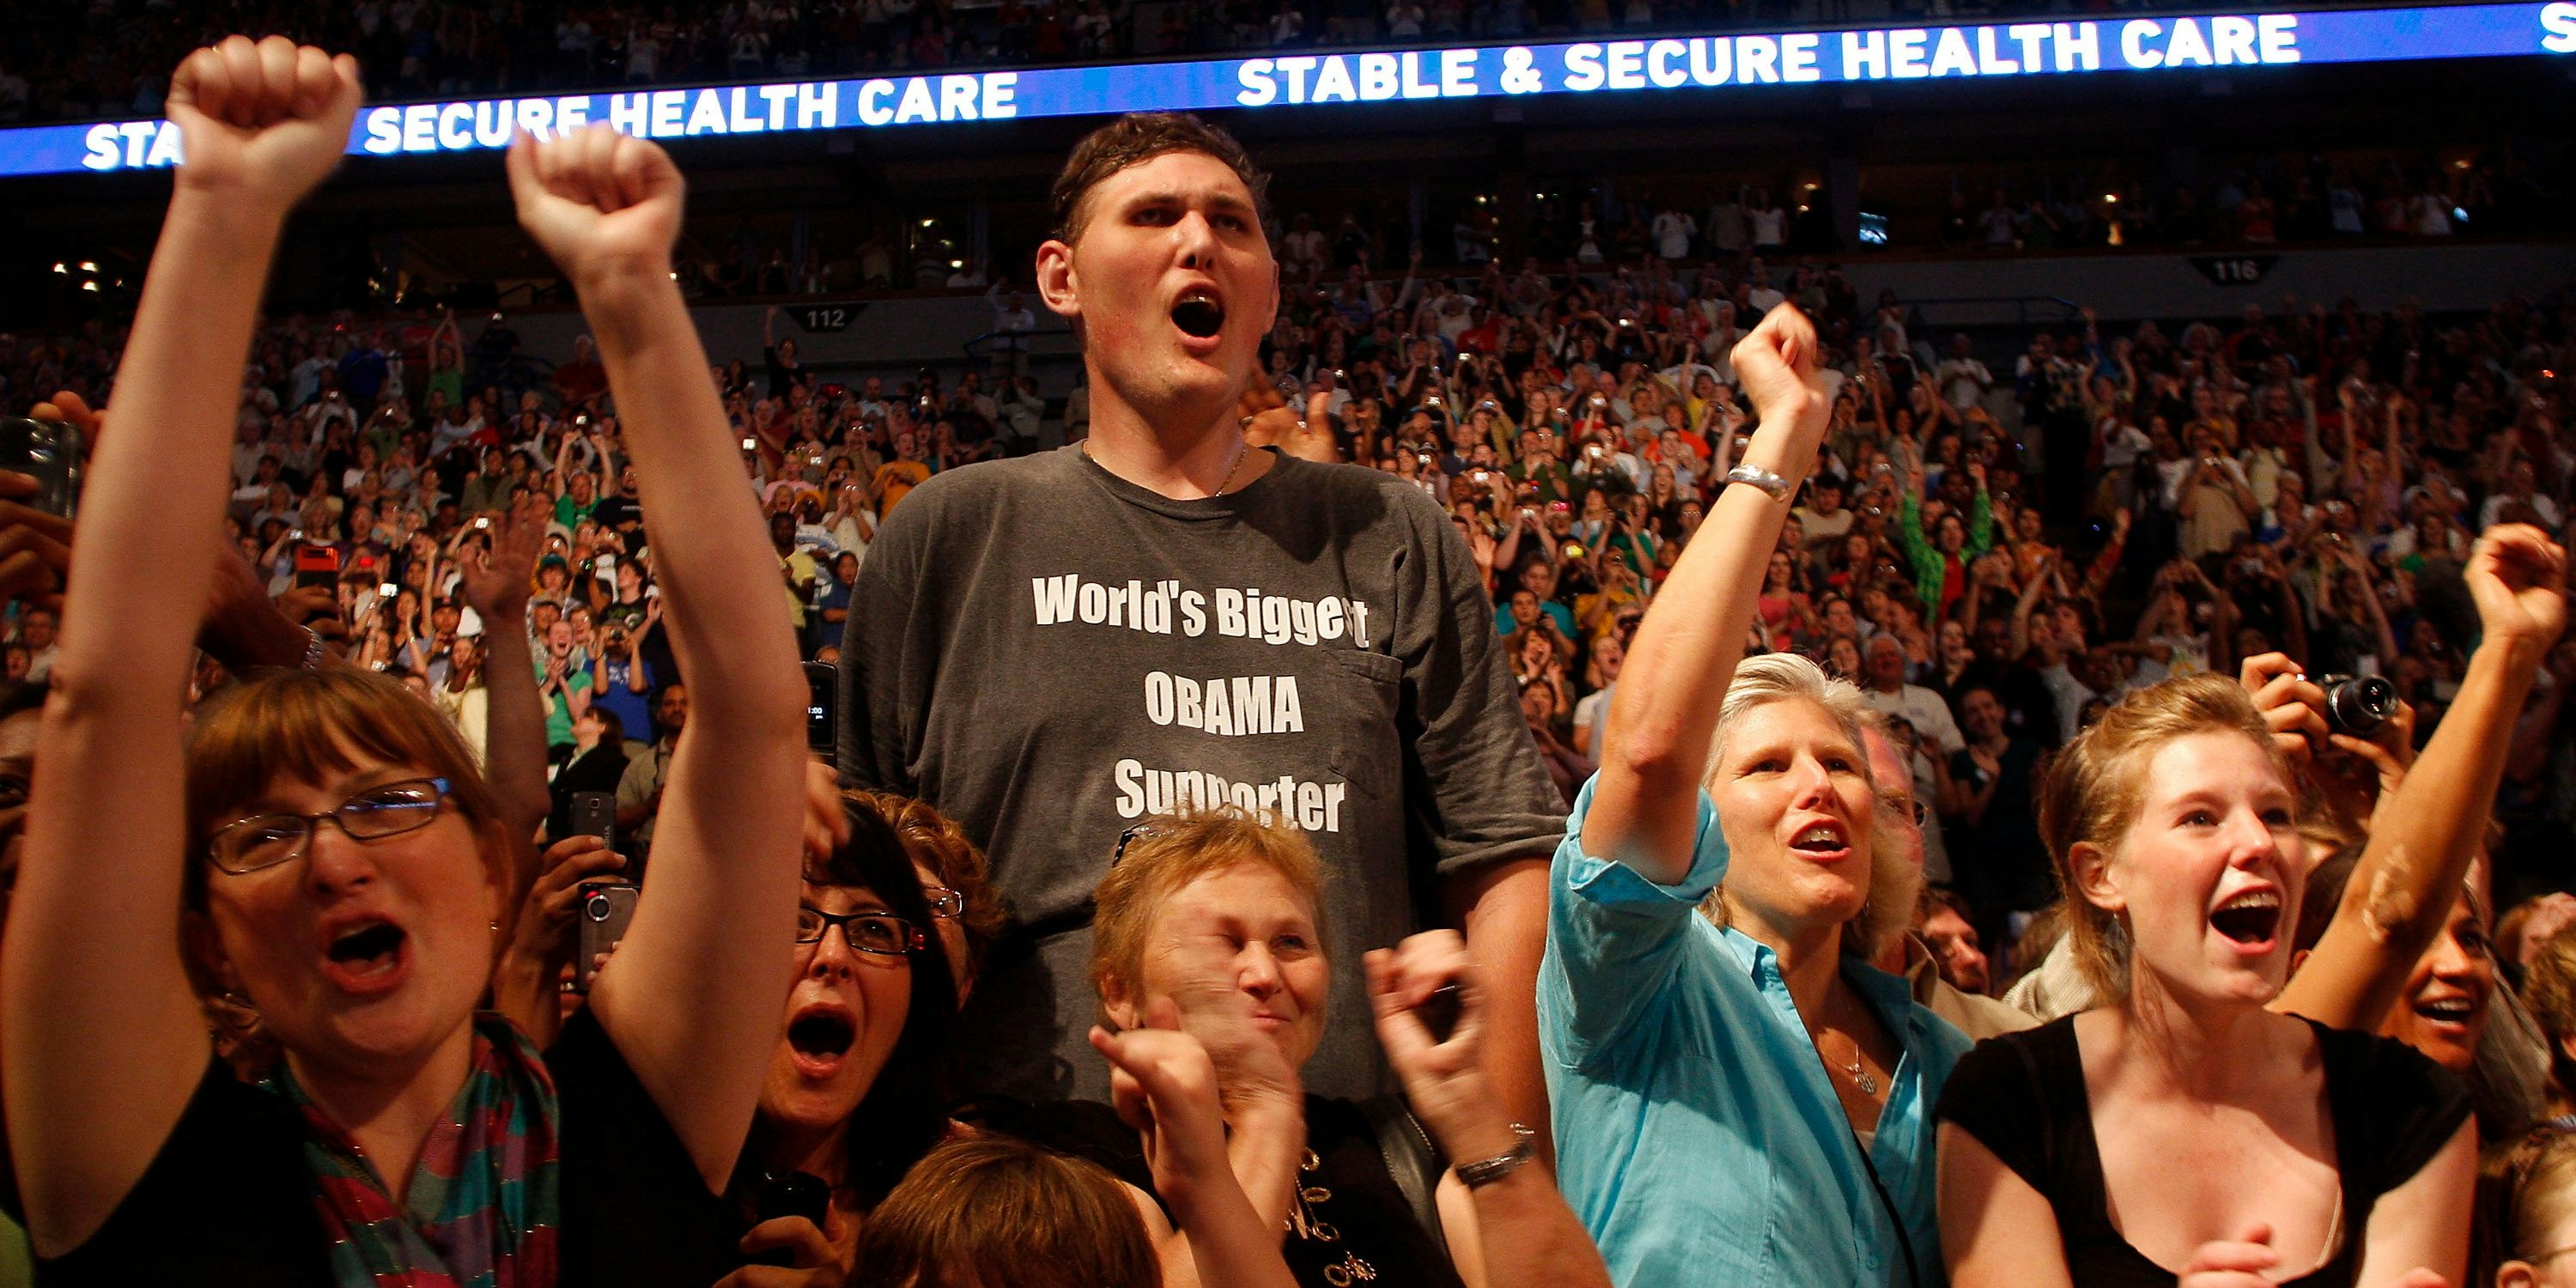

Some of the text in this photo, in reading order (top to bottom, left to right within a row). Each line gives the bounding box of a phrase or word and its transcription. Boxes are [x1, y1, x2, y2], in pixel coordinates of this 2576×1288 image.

[1236, 14, 2301, 106] STABLE & SECURE HEALTH CARE
[82, 120, 185, 170] STA
[610, 82, 838, 139] HEALTH
[859, 72, 1018, 126] CARE
[2214, 259, 2259, 282] 116
[807, 309, 846, 328] 112
[1032, 574, 1206, 637] World's
[1145, 671, 1305, 736] OBAMA
